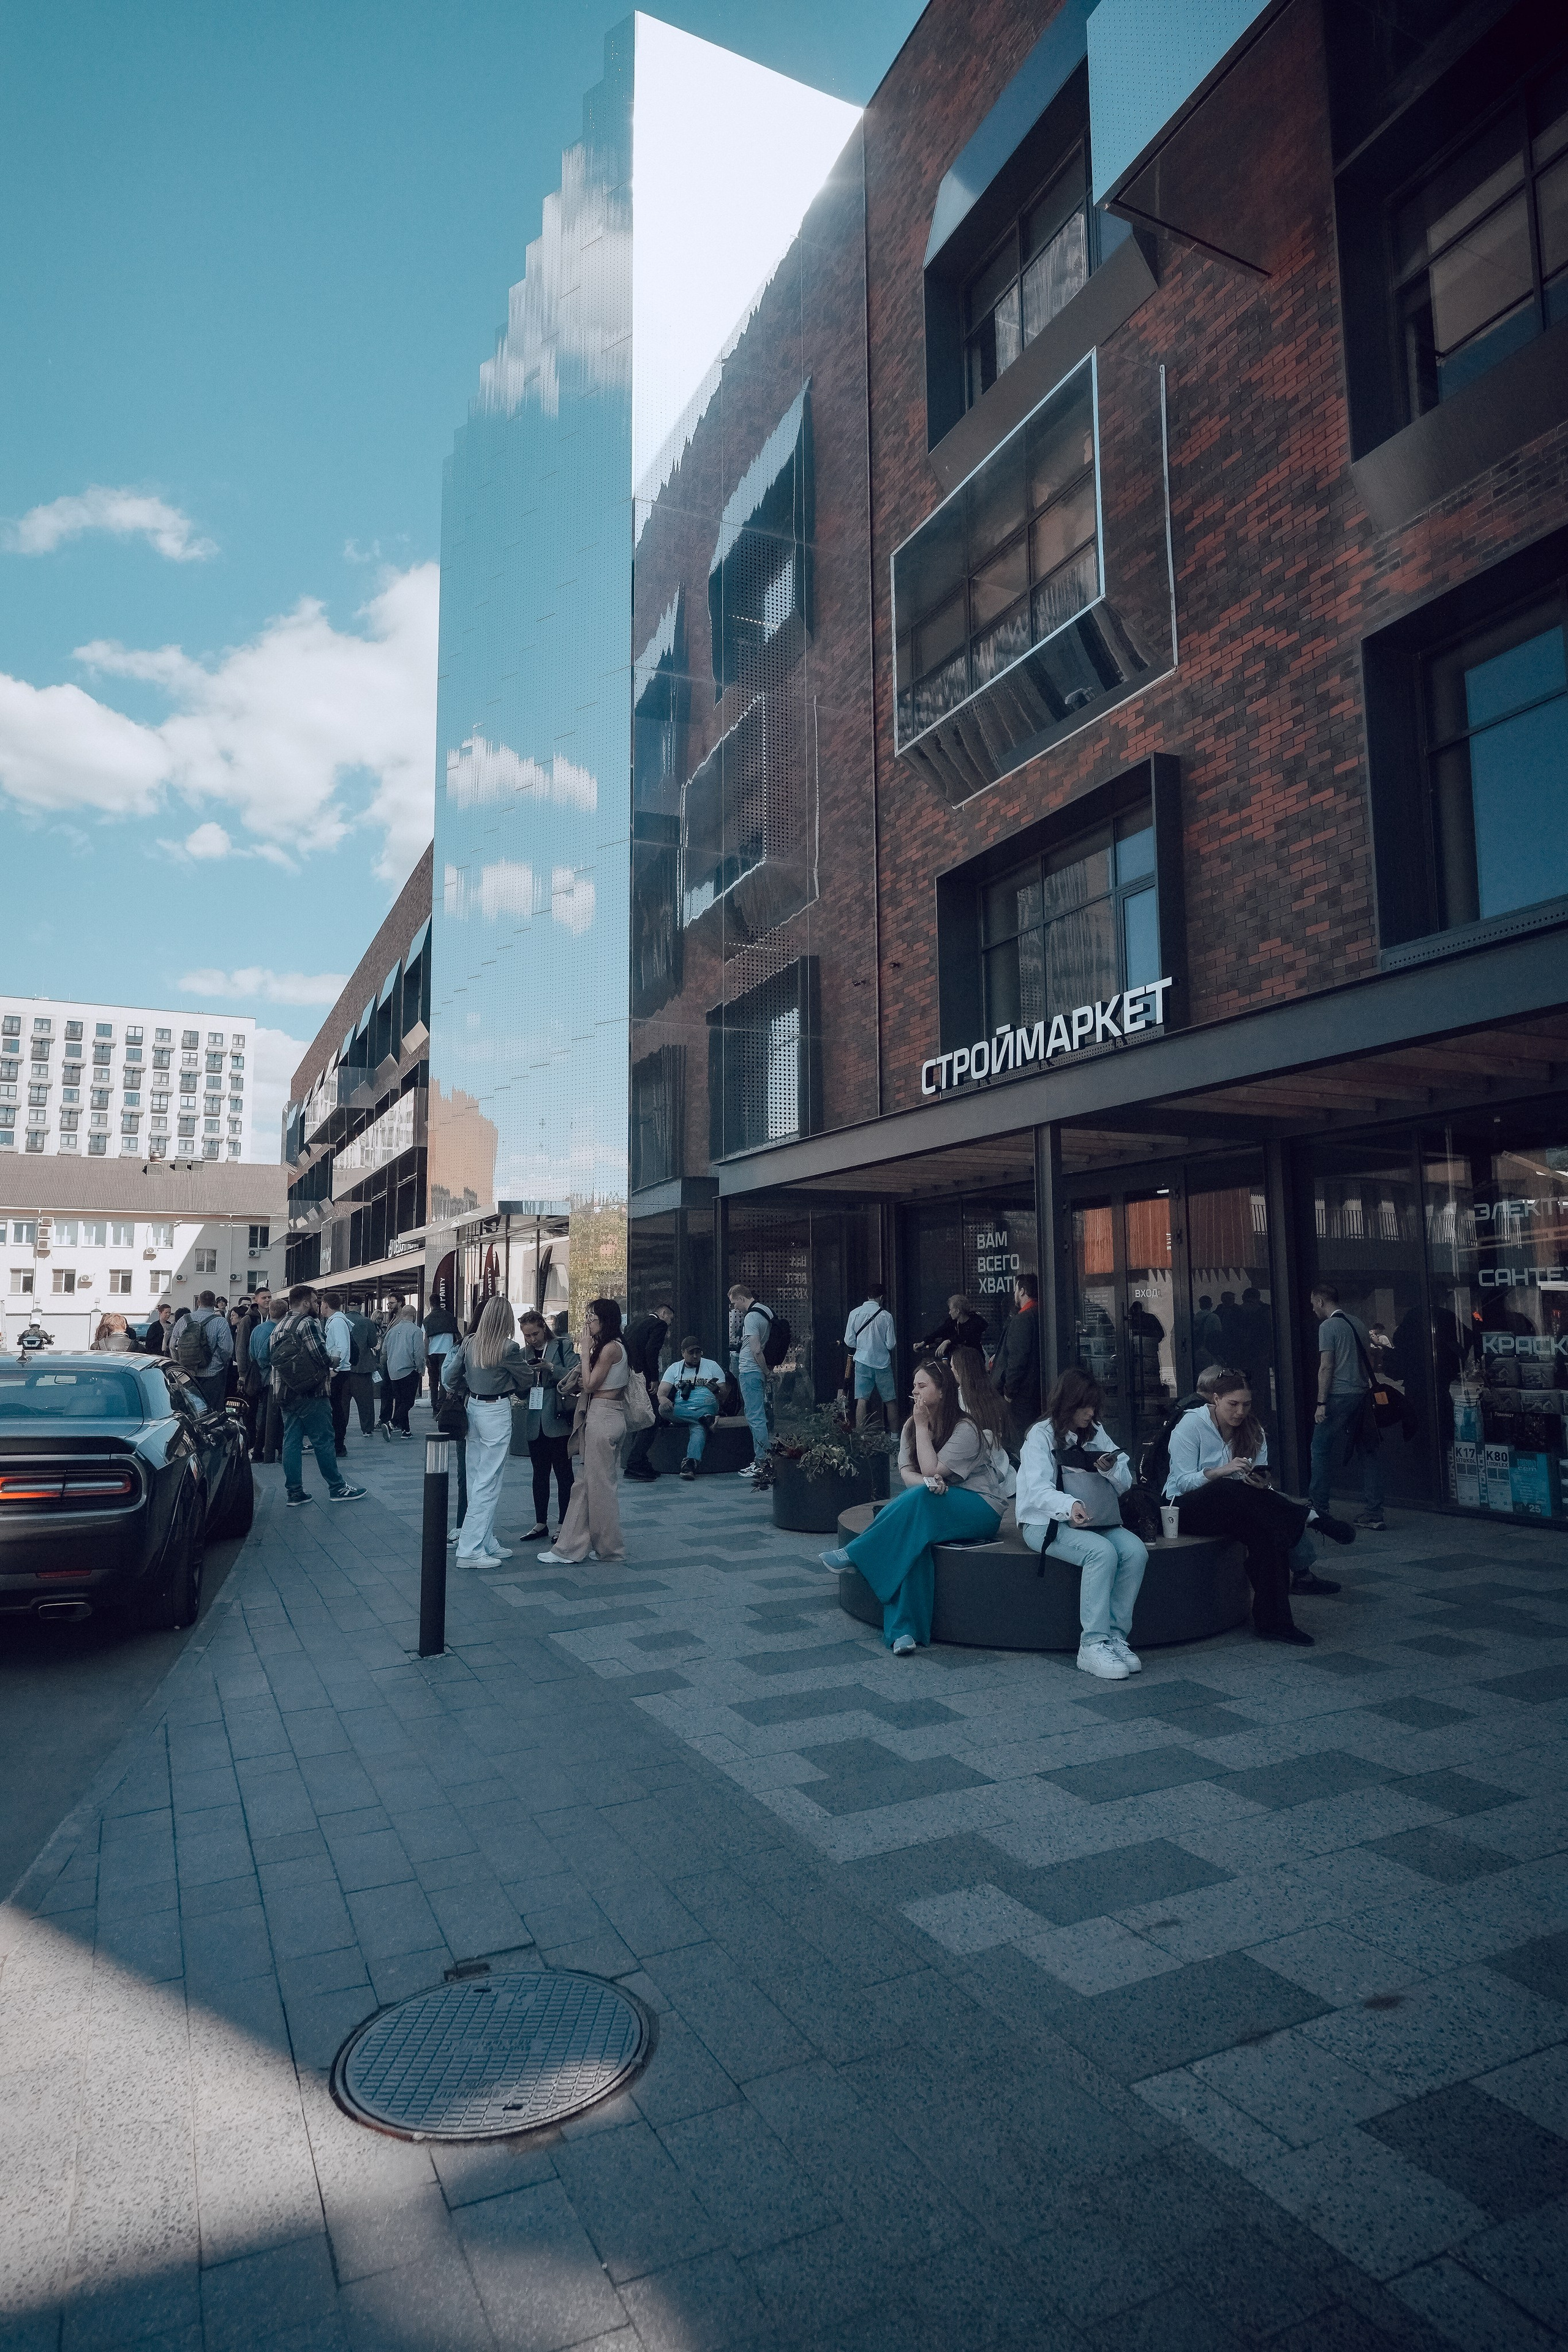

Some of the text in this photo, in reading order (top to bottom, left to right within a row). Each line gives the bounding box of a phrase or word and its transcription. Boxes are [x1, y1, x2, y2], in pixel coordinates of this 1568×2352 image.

[922, 976, 1172, 1095] СТРОЙМАРКЕТ
[977, 1231, 1008, 1250] ВАМ
[978, 1253, 1020, 1273] ВСЕГО
[1478, 1266, 1568, 1287] САНТЕ
[1135, 1288, 1158, 1298] ВХОД
[1487, 1450, 1508, 1462] K80
[1529, 1504, 1541, 1513] 25
